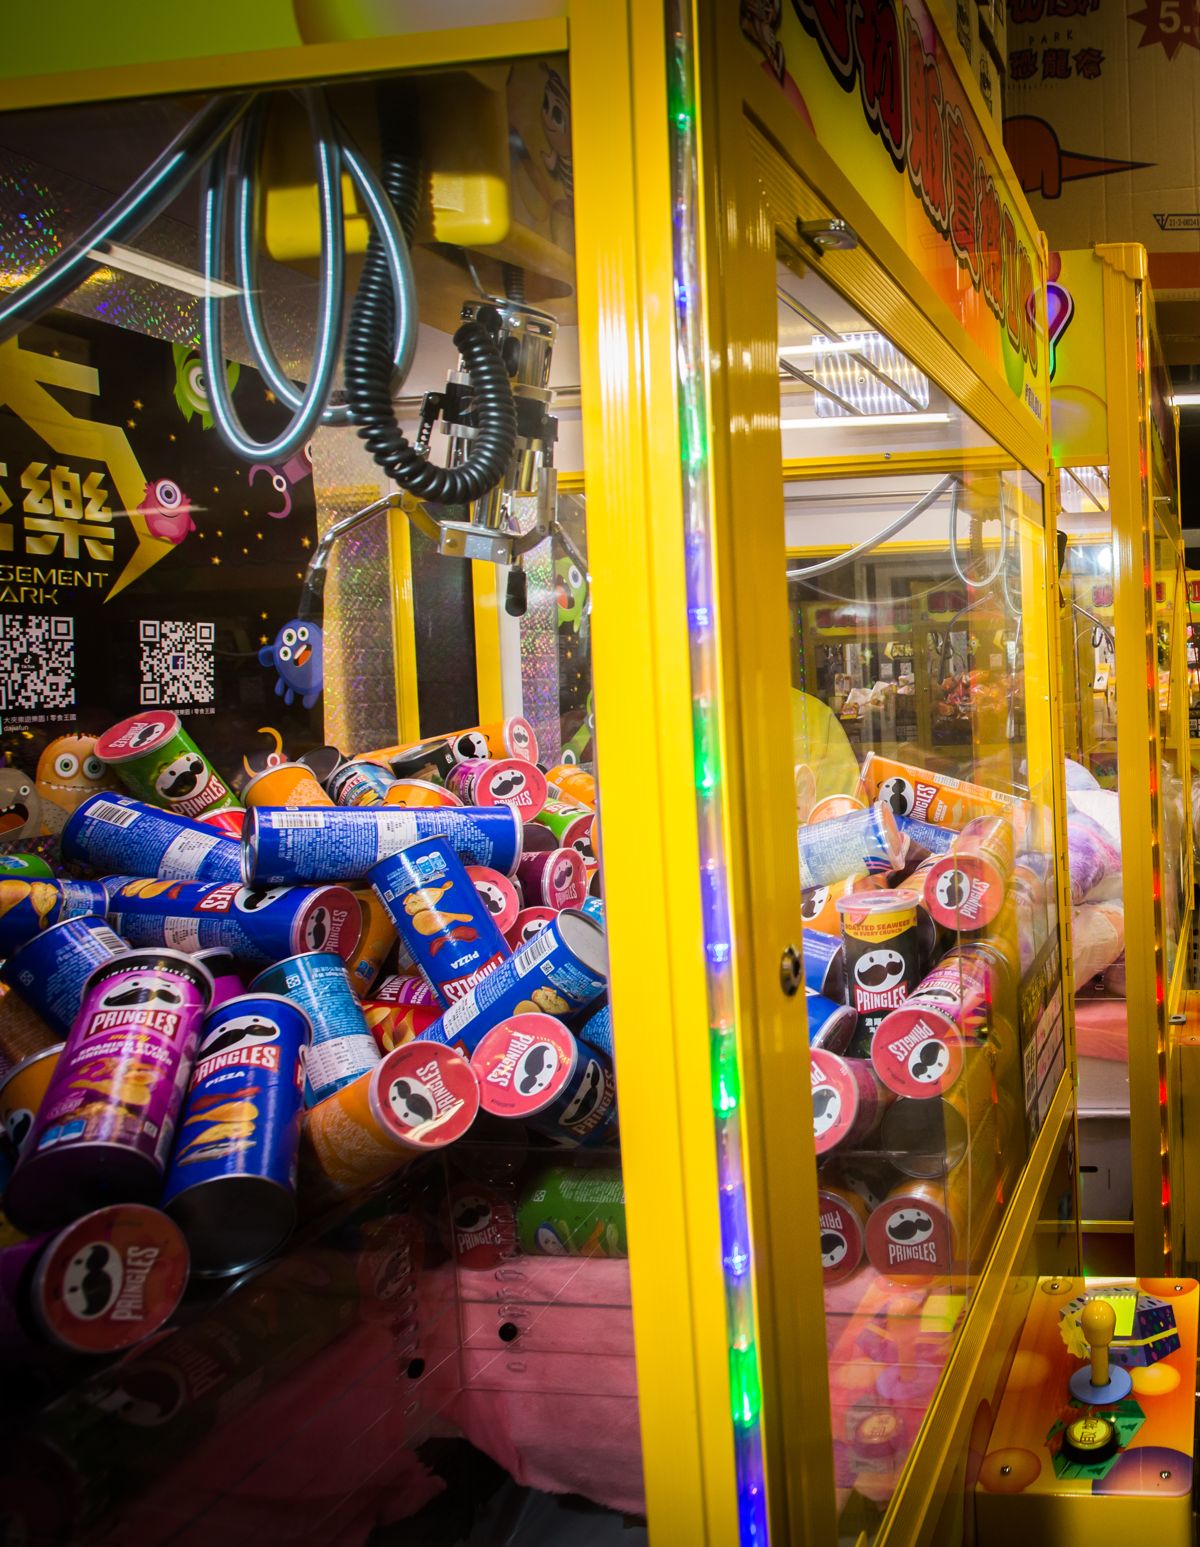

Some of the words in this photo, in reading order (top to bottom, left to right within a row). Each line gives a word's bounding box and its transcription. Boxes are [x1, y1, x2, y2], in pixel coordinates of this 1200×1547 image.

[1028, 29, 1074, 46] PARK
[909, 783, 937, 822] RINGLES
[961, 878, 990, 920] PRINGLES
[327, 909, 348, 954] PRINGLES
[450, 950, 479, 969] PIZZA
[856, 986, 907, 1013] PRINGLES
[89, 1009, 178, 1037] PRINGLES
[888, 1018, 934, 1063] PRINGLES
[190, 1046, 277, 1088] PRINGLES
[487, 1030, 533, 1088] PRINGLES
[204, 1070, 245, 1089] PIZZA
[888, 1243, 937, 1265] PRINGLES
[111, 1245, 159, 1320] PRINGLES
